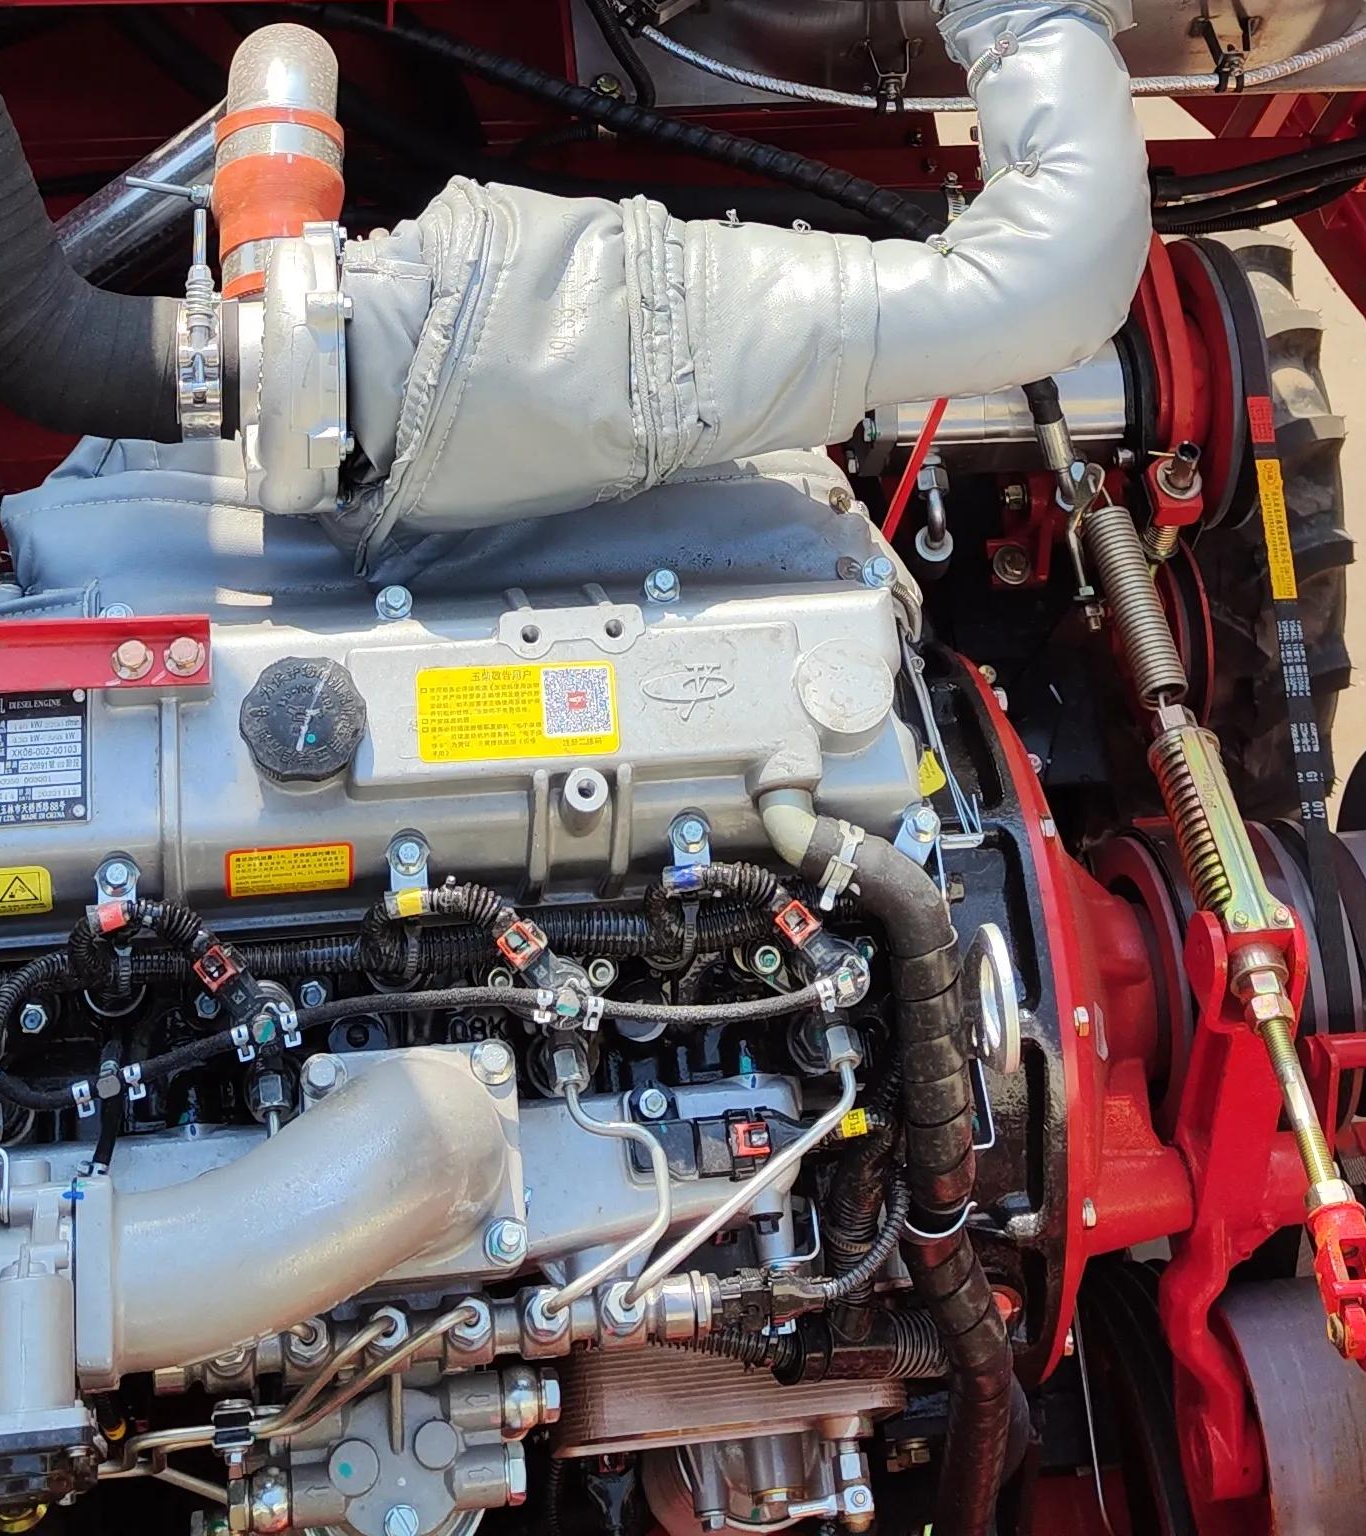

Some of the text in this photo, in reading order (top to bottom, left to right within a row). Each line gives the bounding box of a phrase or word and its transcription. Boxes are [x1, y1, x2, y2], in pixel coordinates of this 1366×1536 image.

[8, 699, 33, 710] DIESEL
[33, 697, 61, 708] ENGINE
[11, 744, 77, 757] XK06-002-00103
[1311, 800, 1327, 820] 017
